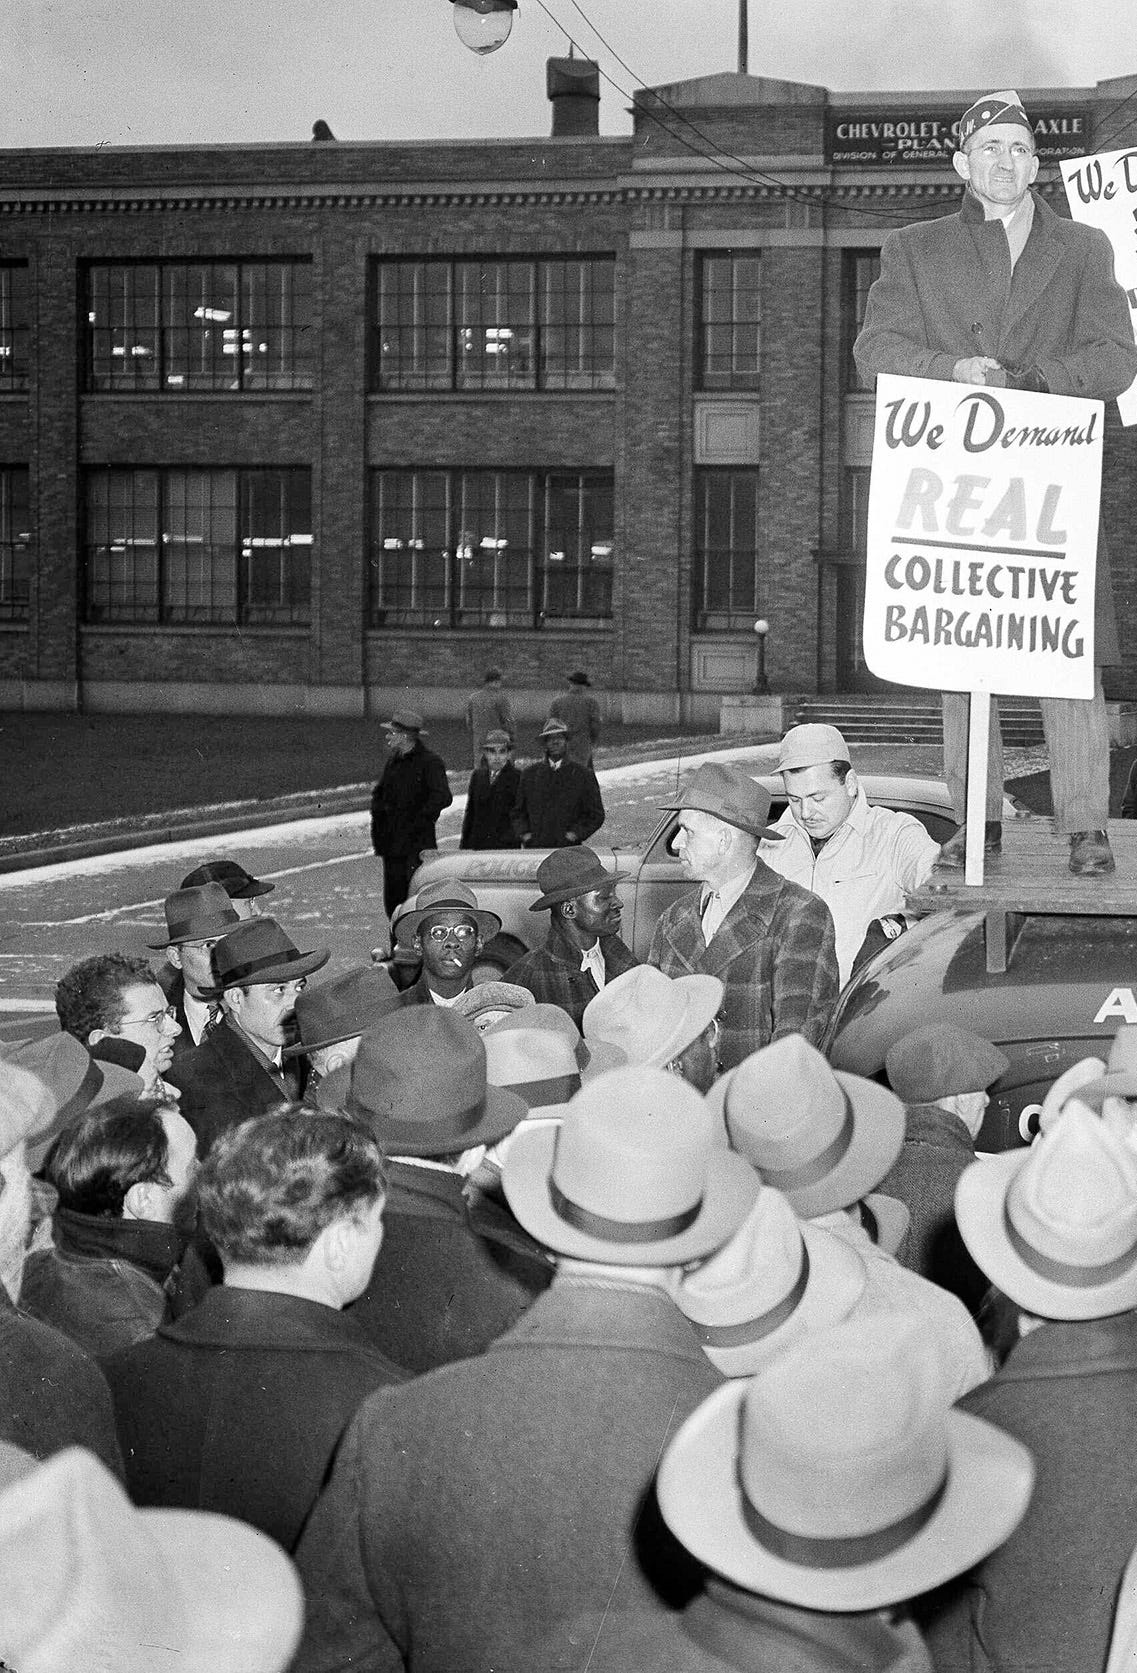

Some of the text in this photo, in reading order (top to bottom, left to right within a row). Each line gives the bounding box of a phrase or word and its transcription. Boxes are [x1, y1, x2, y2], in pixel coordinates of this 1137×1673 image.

[897, 138, 957, 150] PLAN
[1034, 118, 1083, 134] AXLE
[832, 147, 1085, 160] DIVISION OF GENERAL ORATION
[1068, 159, 1118, 204] We
[884, 392, 1099, 453] We Demand
[895, 467, 1068, 546] REAL
[884, 554, 1079, 605] COLLECTIVE
[884, 604, 1085, 659] BARGAINING
